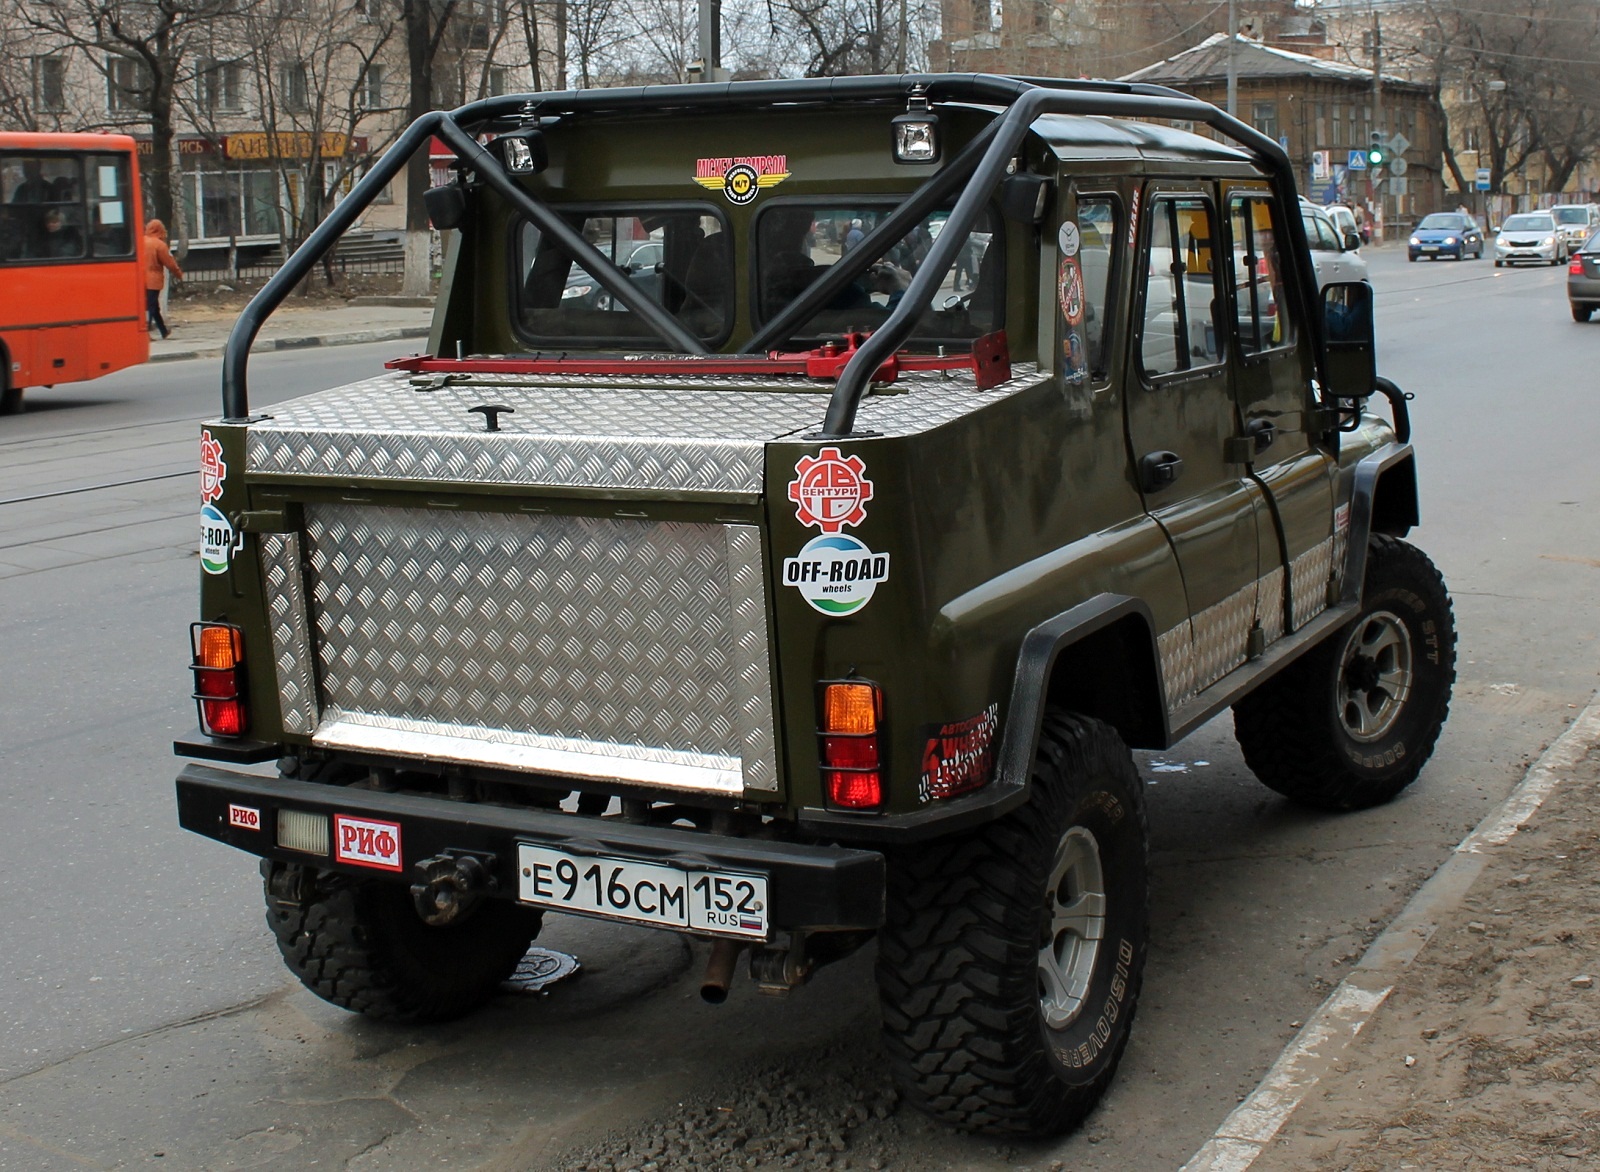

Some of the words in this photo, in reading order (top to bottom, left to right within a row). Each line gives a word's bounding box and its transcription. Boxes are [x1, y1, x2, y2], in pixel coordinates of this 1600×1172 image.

[235, 138, 342, 155] АНИАР
[802, 487, 858, 497] ВЕНТУРИ
[787, 556, 886, 583] OFF-ROAD
[822, 584, 853, 594] wheels
[232, 808, 258, 826] РИФ
[341, 824, 396, 859] РИФ
[693, 876, 756, 915] 152
[707, 912, 738, 926] RUS
